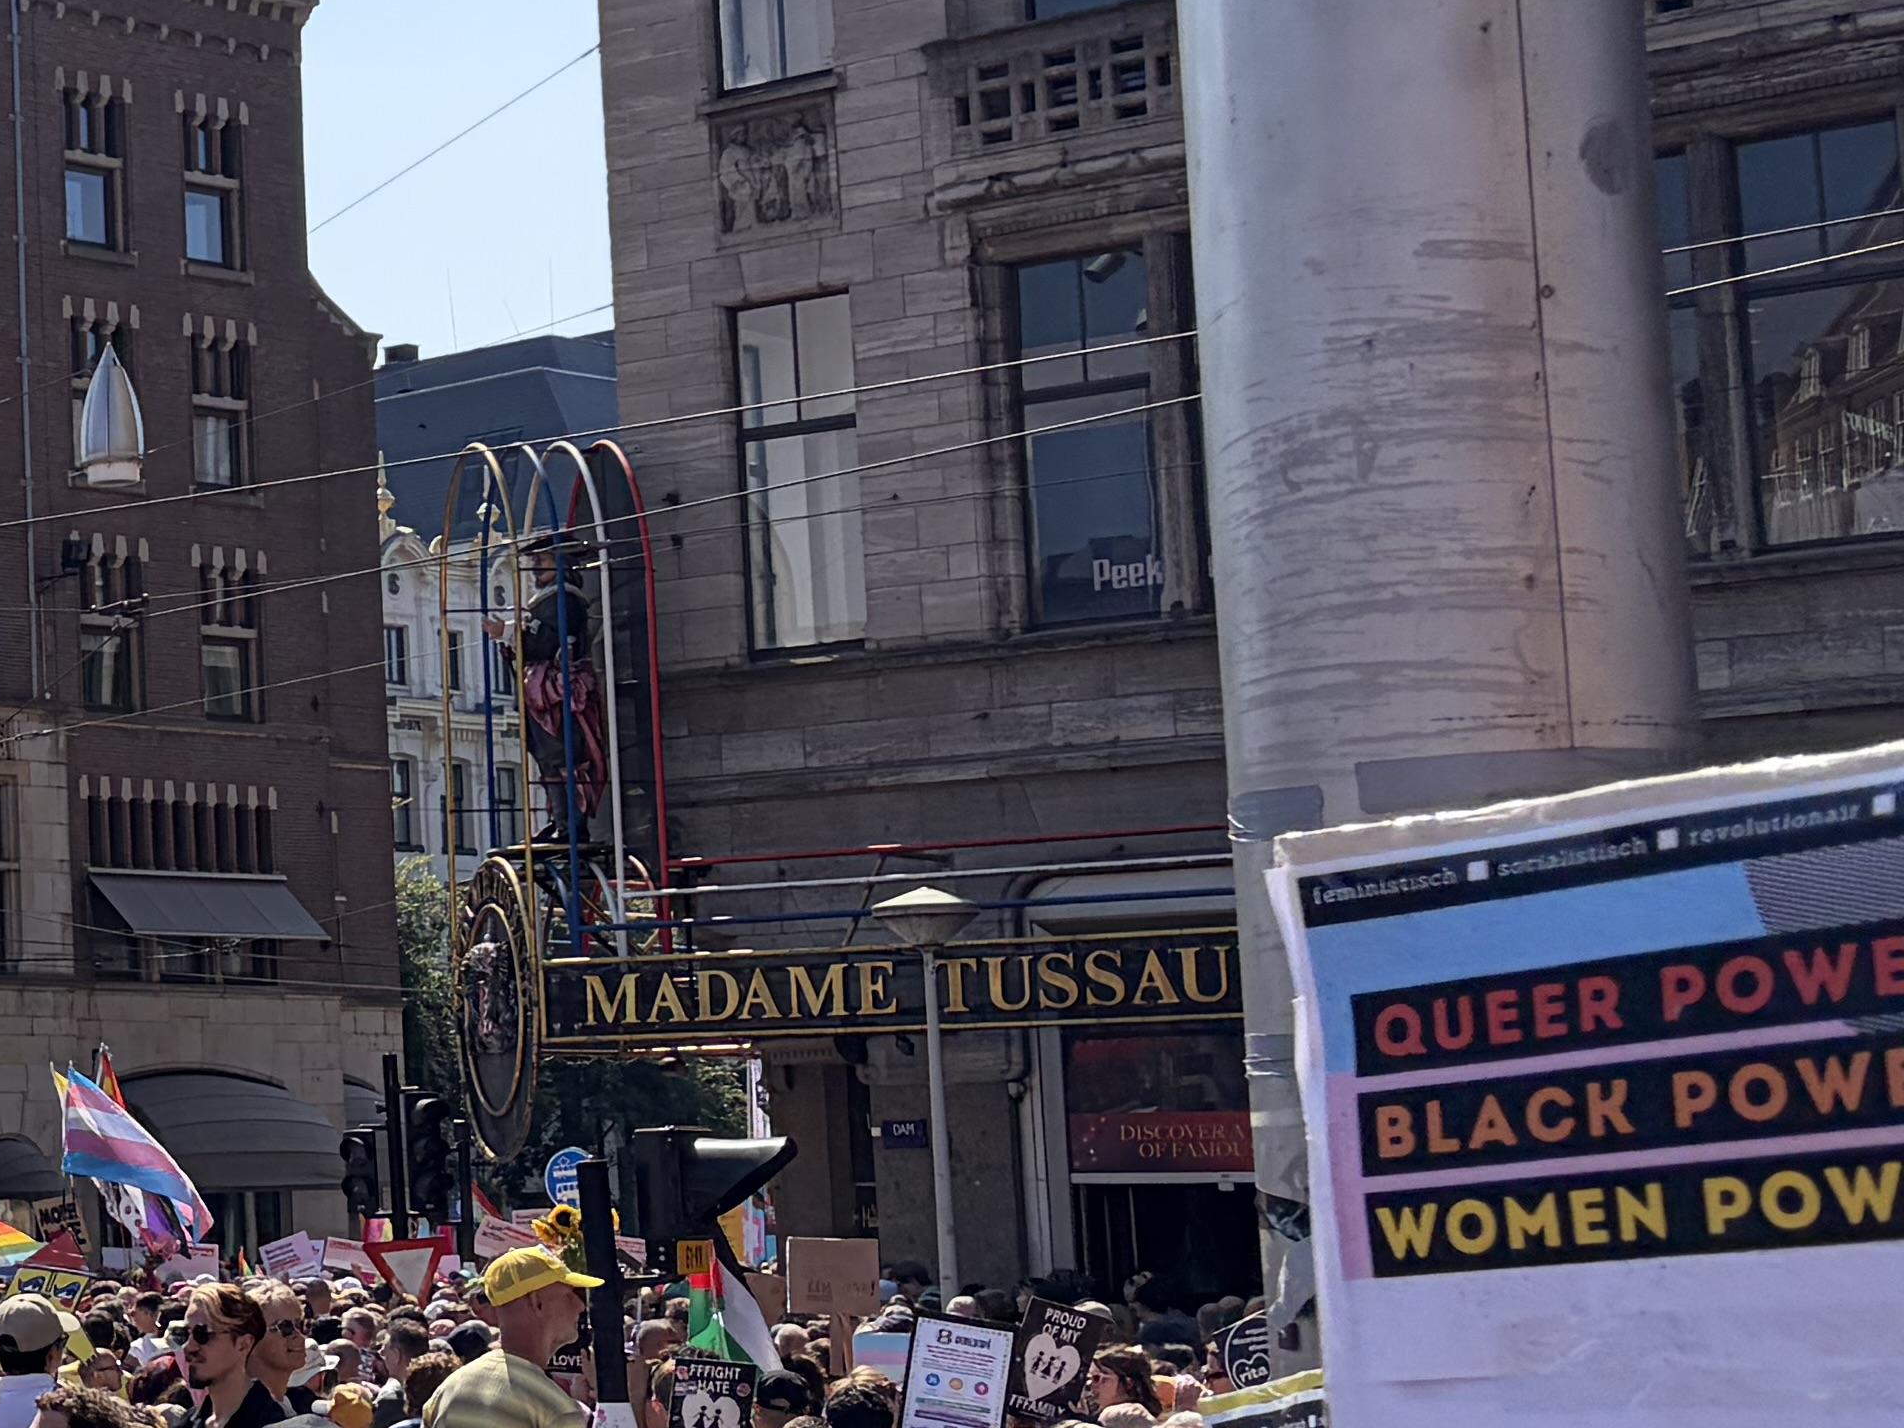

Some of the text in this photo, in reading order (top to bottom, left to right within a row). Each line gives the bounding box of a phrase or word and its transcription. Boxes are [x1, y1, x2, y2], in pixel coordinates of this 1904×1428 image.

[1093, 554, 1163, 592] Peek
[582, 945, 1231, 1027] MADAME TUSSAU
[1374, 974, 1624, 1057] QUEER
[893, 1122, 915, 1137] DAM
[1374, 1079, 1636, 1159] BLACK
[1120, 1123, 1220, 1142] DISCOVER
[1138, 1141, 1167, 1159] OF
[1375, 1161, 1903, 1261] WOMEN POW
[1044, 1307, 1087, 1330] PROUD
[1042, 1322, 1082, 1343] OF MY
[551, 1354, 582, 1367] LOVE
[1239, 1365, 1268, 1383] rita
[700, 1379, 730, 1396] HATE
